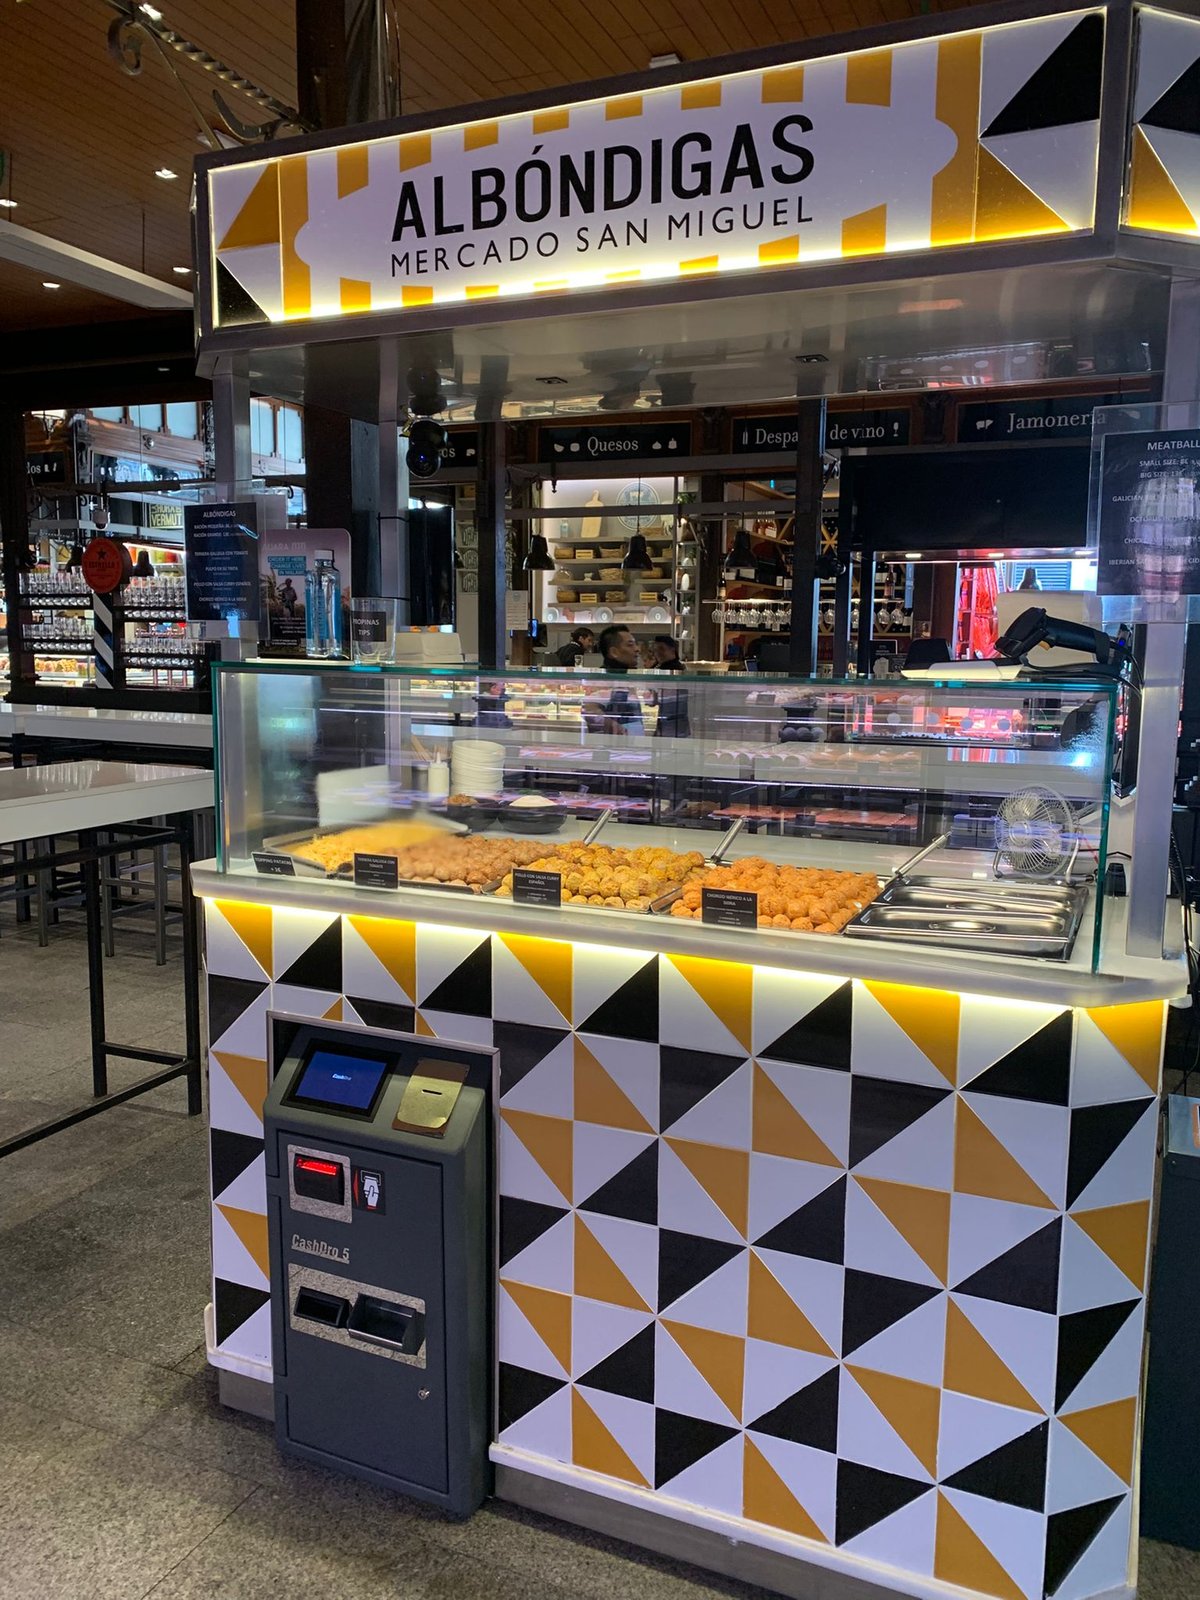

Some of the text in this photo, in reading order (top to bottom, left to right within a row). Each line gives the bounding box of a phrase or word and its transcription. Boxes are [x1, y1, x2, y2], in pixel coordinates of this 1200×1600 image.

[391, 114, 815, 242] ALBÓNDIGAS
[391, 195, 813, 277] MERCADO SAN MIGUEL
[755, 427, 799, 448] Despa
[829, 423, 885, 440] de vino
[587, 437, 639, 456] Quesos
[1140, 471, 1152, 479] BIG
[151, 513, 183, 527] VERMUT
[203, 510, 236, 518] ALBÓNDIGAS
[291, 1233, 350, 1261] CashDro 5
